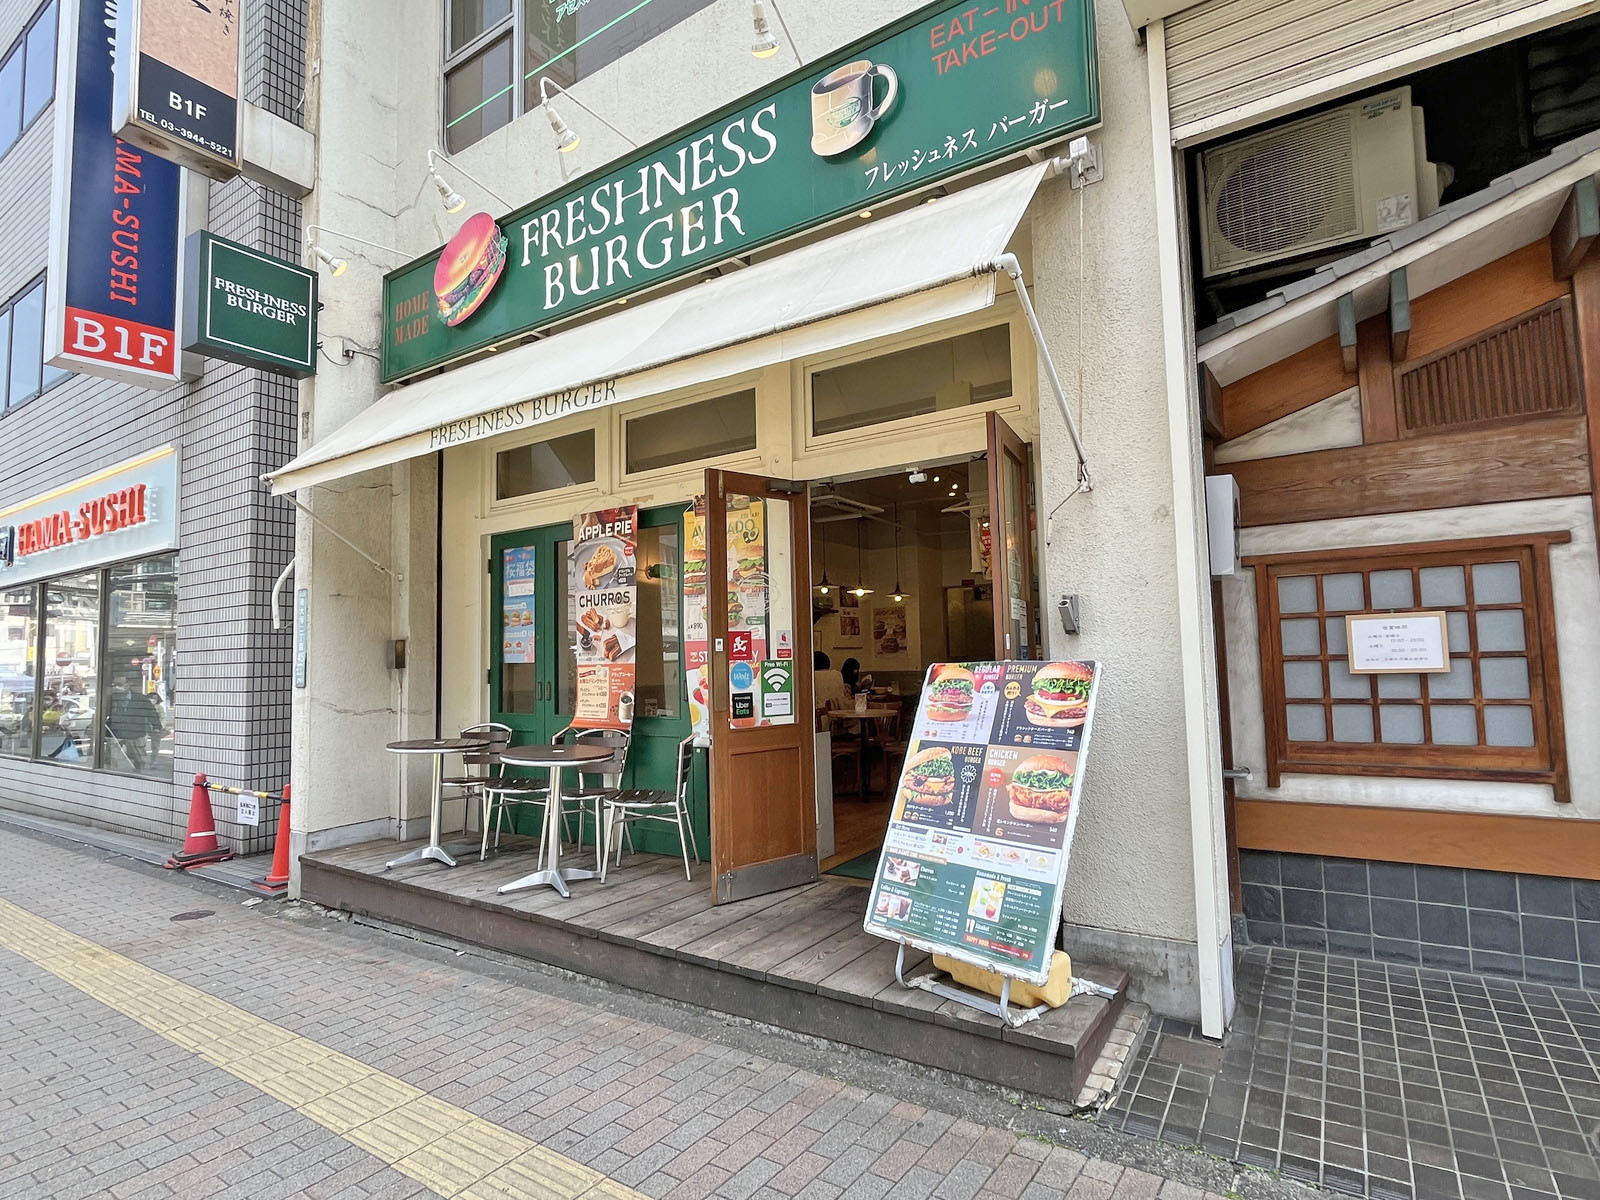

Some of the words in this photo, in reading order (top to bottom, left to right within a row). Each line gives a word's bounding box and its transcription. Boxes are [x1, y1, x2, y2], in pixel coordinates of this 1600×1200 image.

[931, 0, 1067, 76] TAKE-OUT
[168, 90, 208, 121] B1F
[139, 108, 157, 125] TEL
[160, 117, 233, 158] 03-3944-5221
[864, 127, 979, 191] フレッシュネス
[987, 98, 1069, 142] バーガー
[519, 102, 779, 268] FRESHNESS
[110, 140, 143, 306] MA-SUSHI
[542, 187, 746, 310] BURGER
[214, 276, 308, 317] FRESHNESS
[226, 294, 297, 326] BURGER
[395, 290, 431, 322] HOME
[71, 315, 169, 366] B1F
[394, 314, 430, 346] MADE
[429, 401, 526, 449] FRESHNESS
[532, 380, 617, 421] BURGER
[17, 483, 147, 556] HAMA-SUSHI
[578, 522, 613, 540] APPLE
[614, 520, 633, 536] PIE
[692, 518, 756, 539] AVADO
[579, 591, 631, 608] CHURROS
[733, 672, 750, 681] Wolt
[974, 664, 1001, 675] REGULAR
[983, 673, 1000, 681] BURGER
[1005, 673, 1023, 681] BURGER
[1006, 664, 1039, 674] PREMIUM
[735, 701, 750, 709] Uber
[951, 746, 967, 755] KOBE
[967, 746, 984, 756] BEEF
[964, 756, 982, 764] BURGER
[987, 758, 1006, 767] BURGER
[989, 748, 1019, 760] CHICKEN
